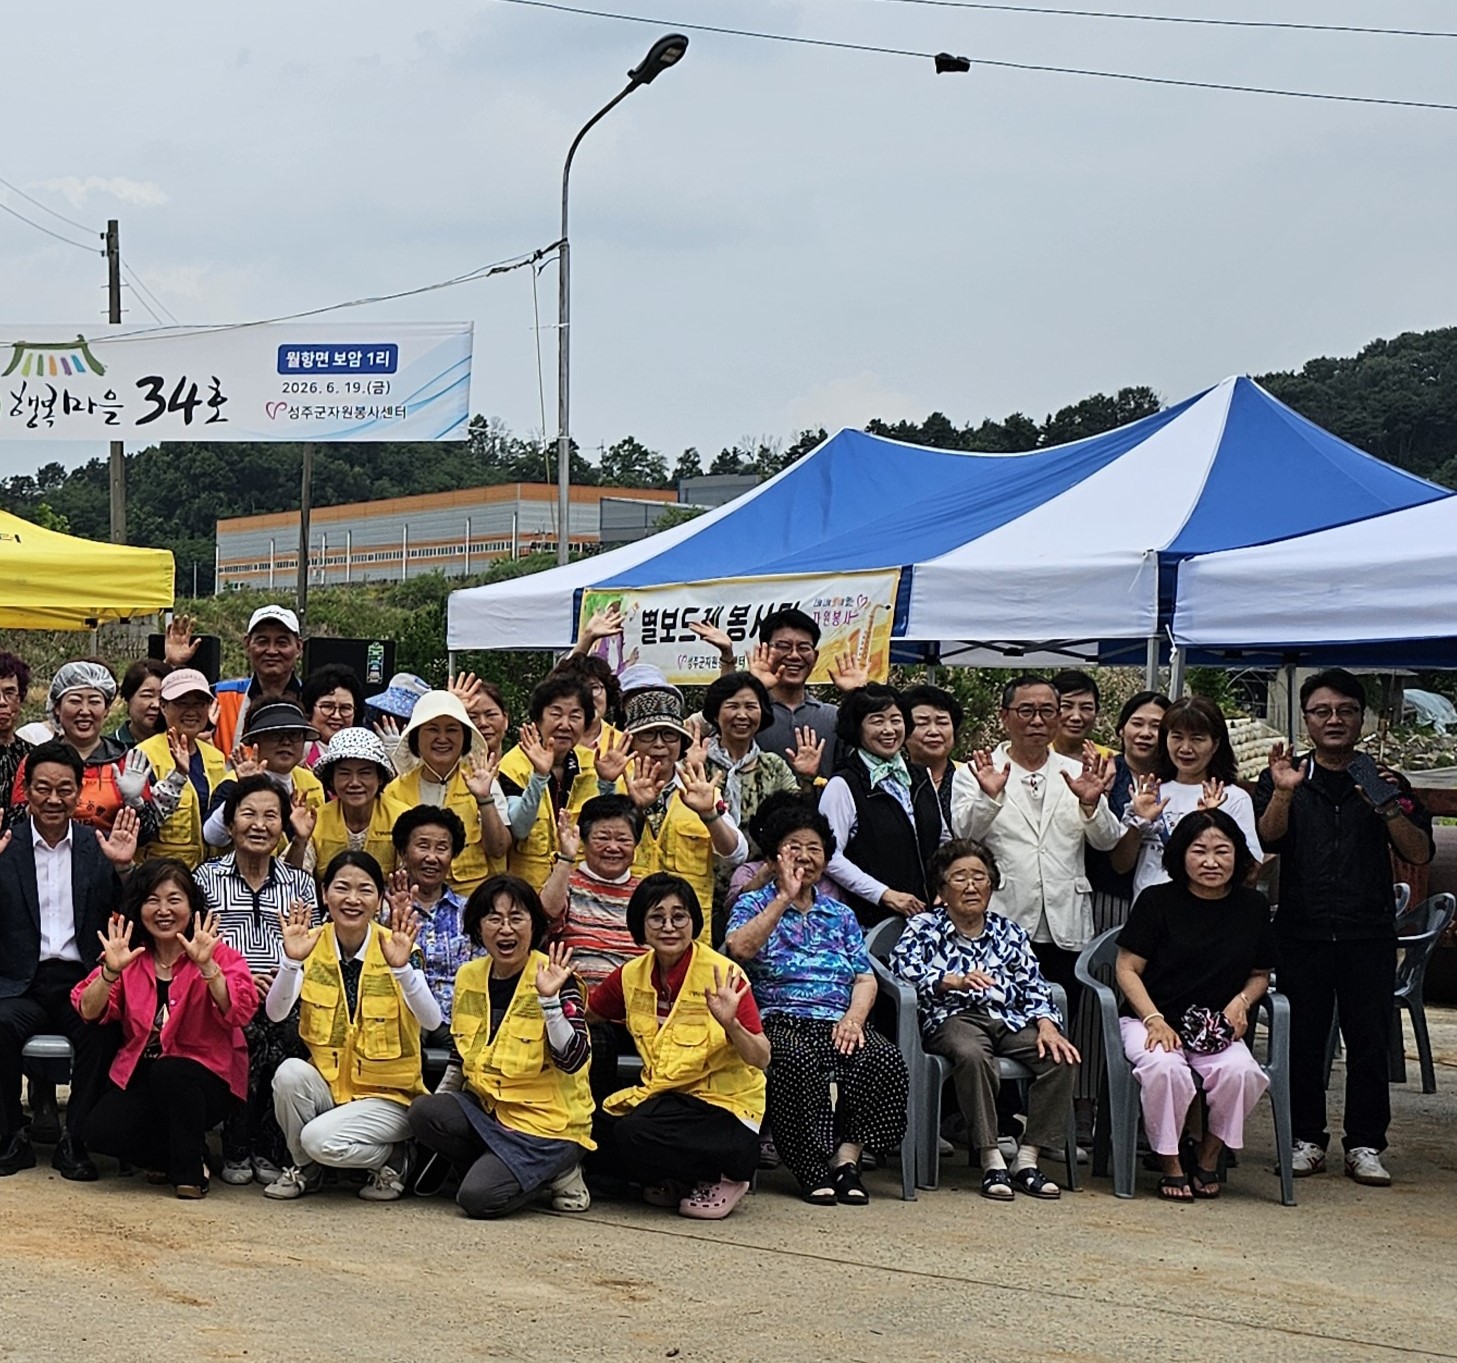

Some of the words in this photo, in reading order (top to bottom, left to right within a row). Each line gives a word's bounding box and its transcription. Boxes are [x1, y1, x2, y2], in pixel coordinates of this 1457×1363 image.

[286, 351, 329, 368] 월항면
[332, 350, 363, 368] 보암
[366, 350, 390, 368] 1리
[282, 382, 322, 394] 2026.
[326, 382, 339, 394] 6.
[345, 380, 391, 395] 19.(금)
[9, 380, 125, 428] 행복마을
[134, 375, 229, 427] 34호
[288, 405, 406, 420] 성주군자원봉사센터
[726, 600, 801, 642] 봉사
[687, 655, 746, 671] 성주군자원터
